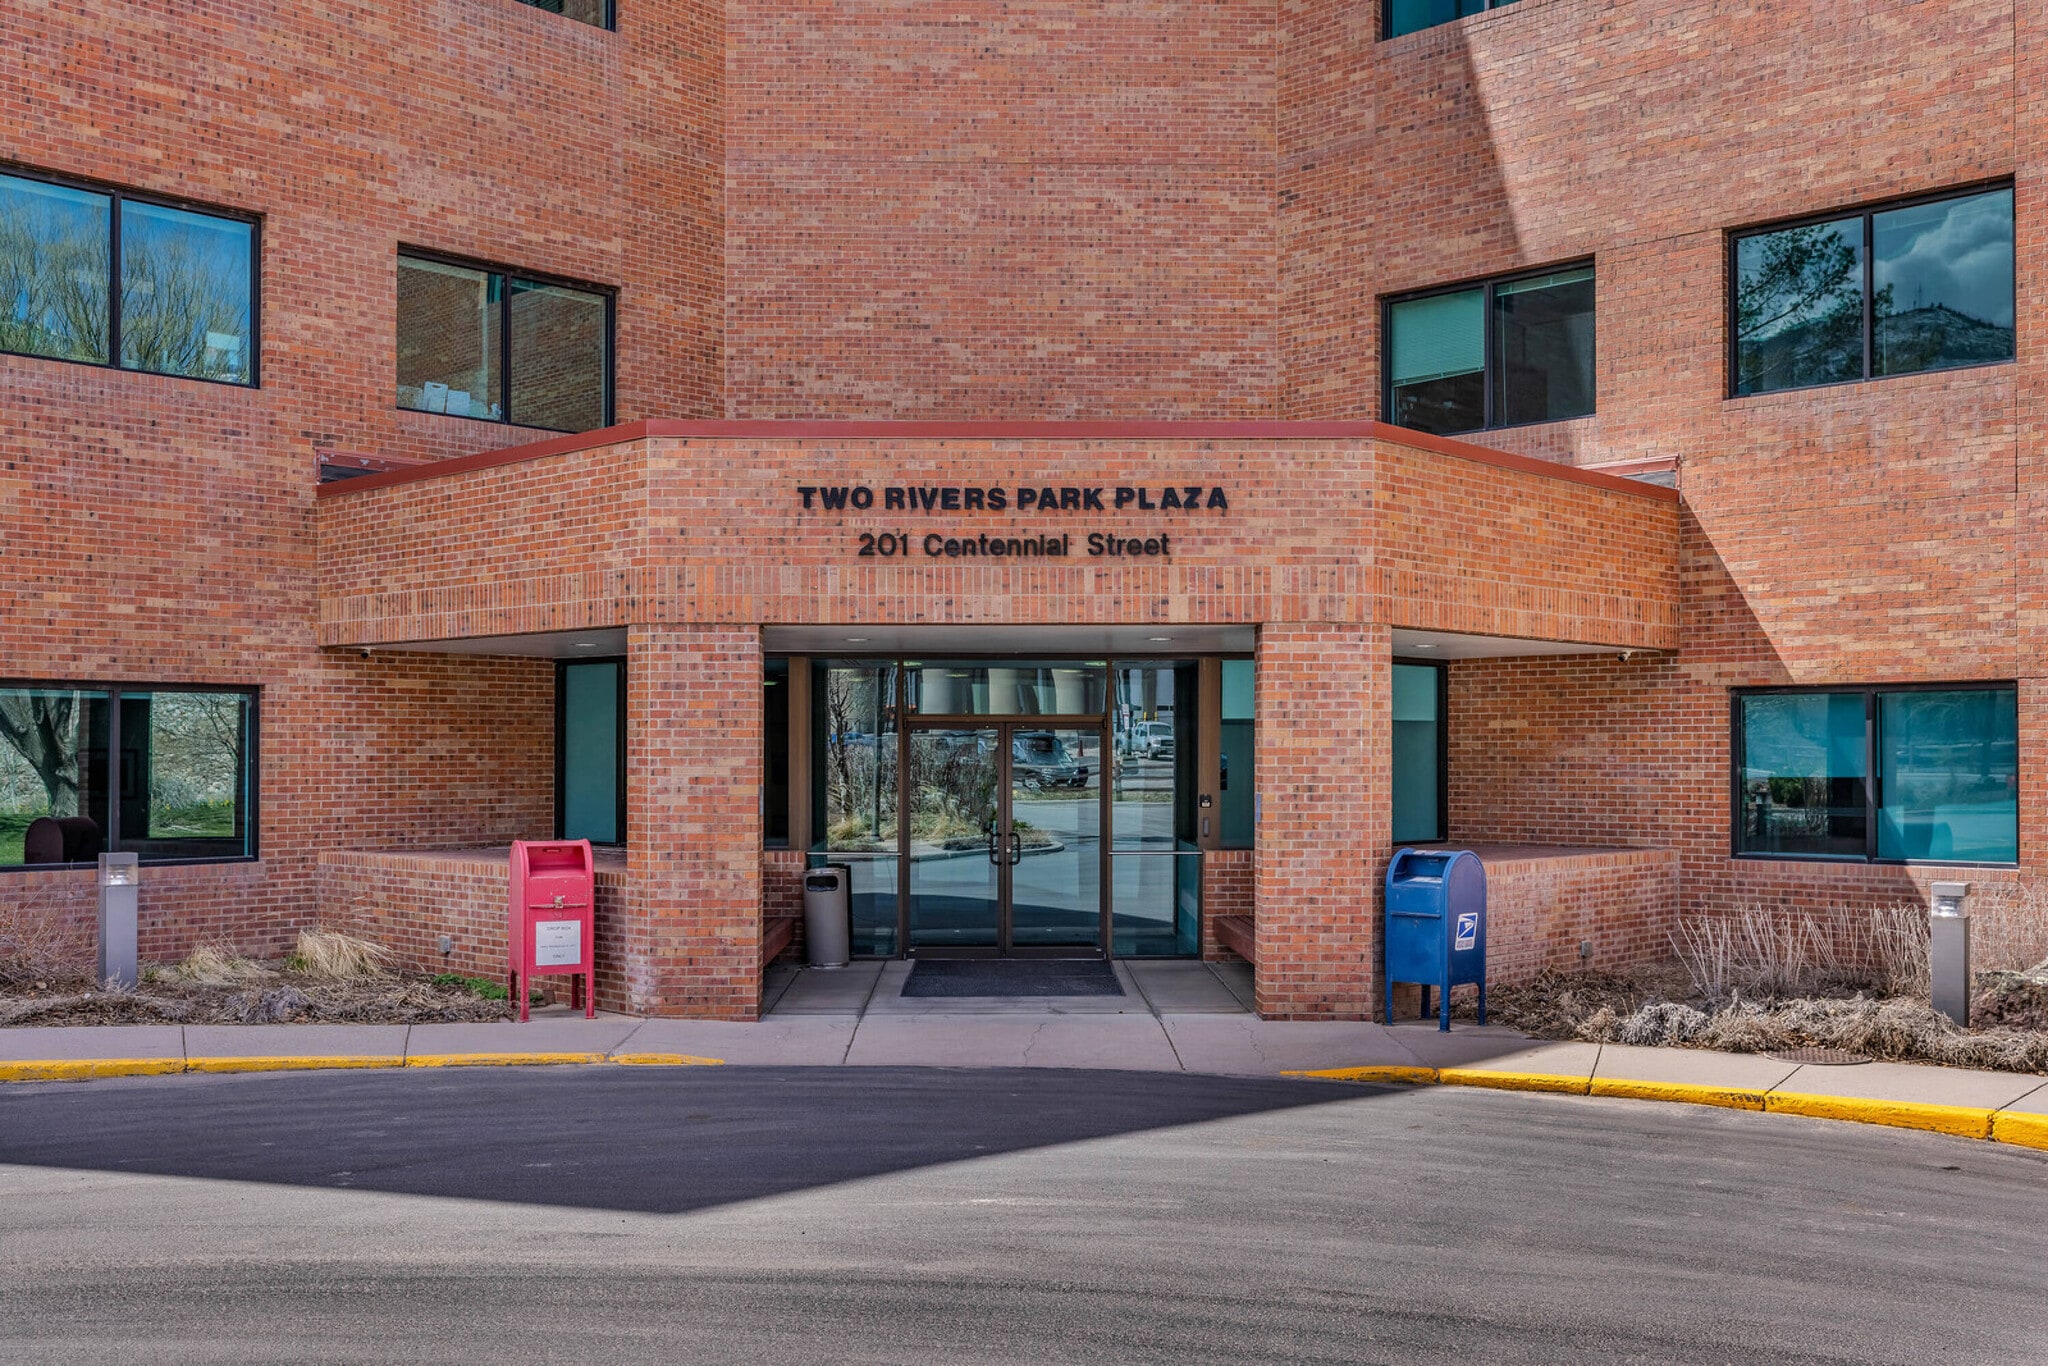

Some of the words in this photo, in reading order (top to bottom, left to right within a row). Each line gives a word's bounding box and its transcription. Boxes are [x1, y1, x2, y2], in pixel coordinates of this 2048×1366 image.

[798, 487, 874, 510] TWO
[885, 487, 1007, 510] RIVERS
[1017, 487, 1105, 511] PARK
[1115, 487, 1229, 510] PLAZA
[858, 534, 910, 557] 201
[923, 533, 1069, 557] Centennial
[1087, 533, 1170, 557] Street
